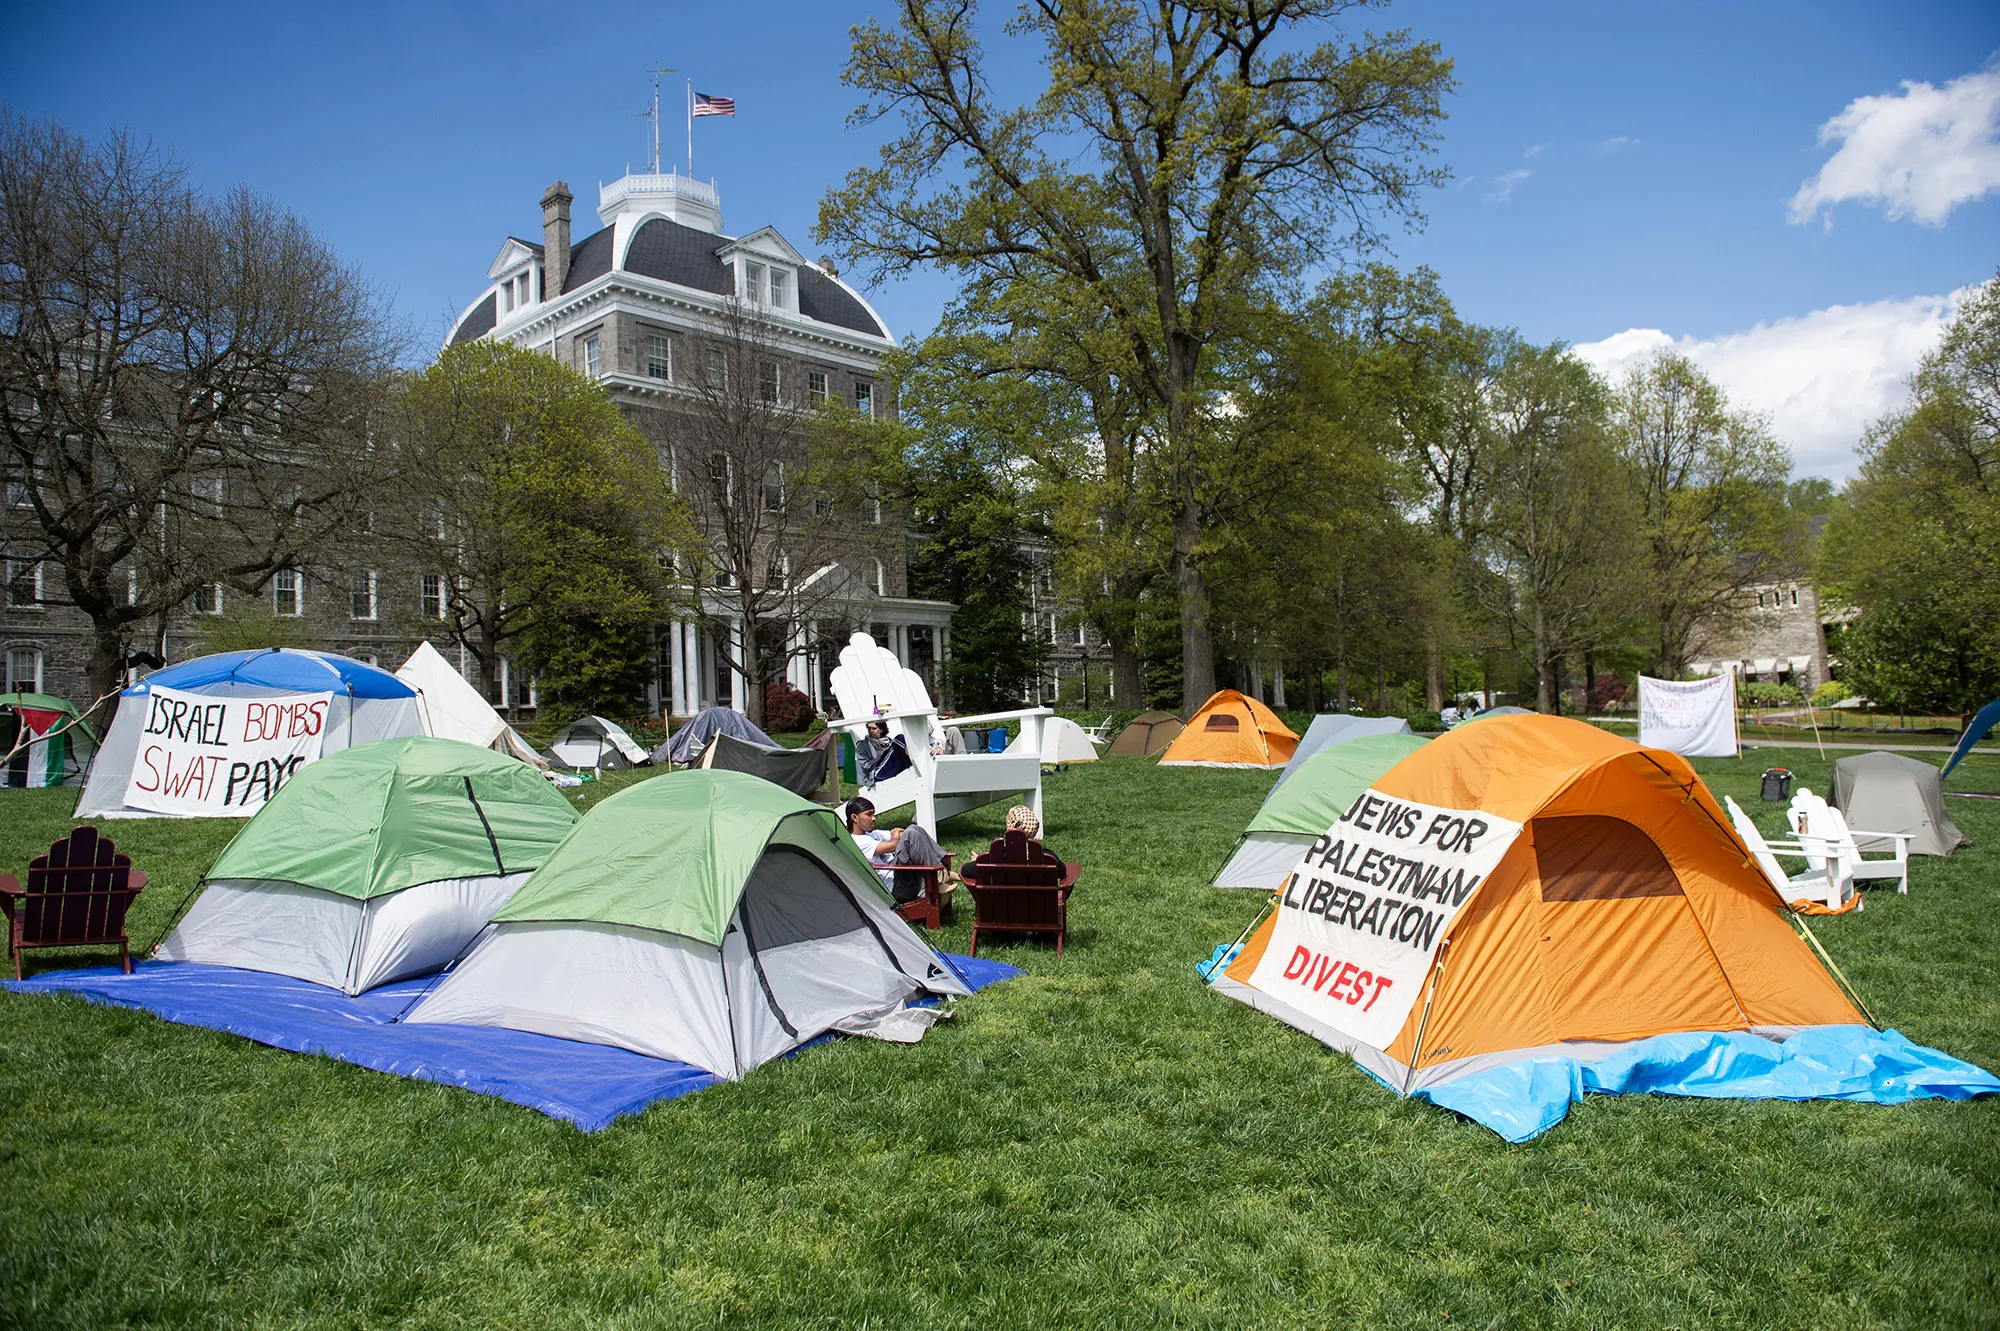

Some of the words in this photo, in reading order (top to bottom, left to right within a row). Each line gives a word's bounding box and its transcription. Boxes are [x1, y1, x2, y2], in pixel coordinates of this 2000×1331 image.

[145, 693, 228, 746] ISRAEL
[243, 700, 328, 743] BOMBS
[136, 745, 228, 802] SWAT
[1339, 793, 1422, 839] JEWS
[1419, 813, 1489, 853] FOR
[1304, 834, 1481, 908] PALESTINIAN
[1284, 872, 1445, 952] LIBERATION
[1283, 945, 1393, 1013] DIVEST
